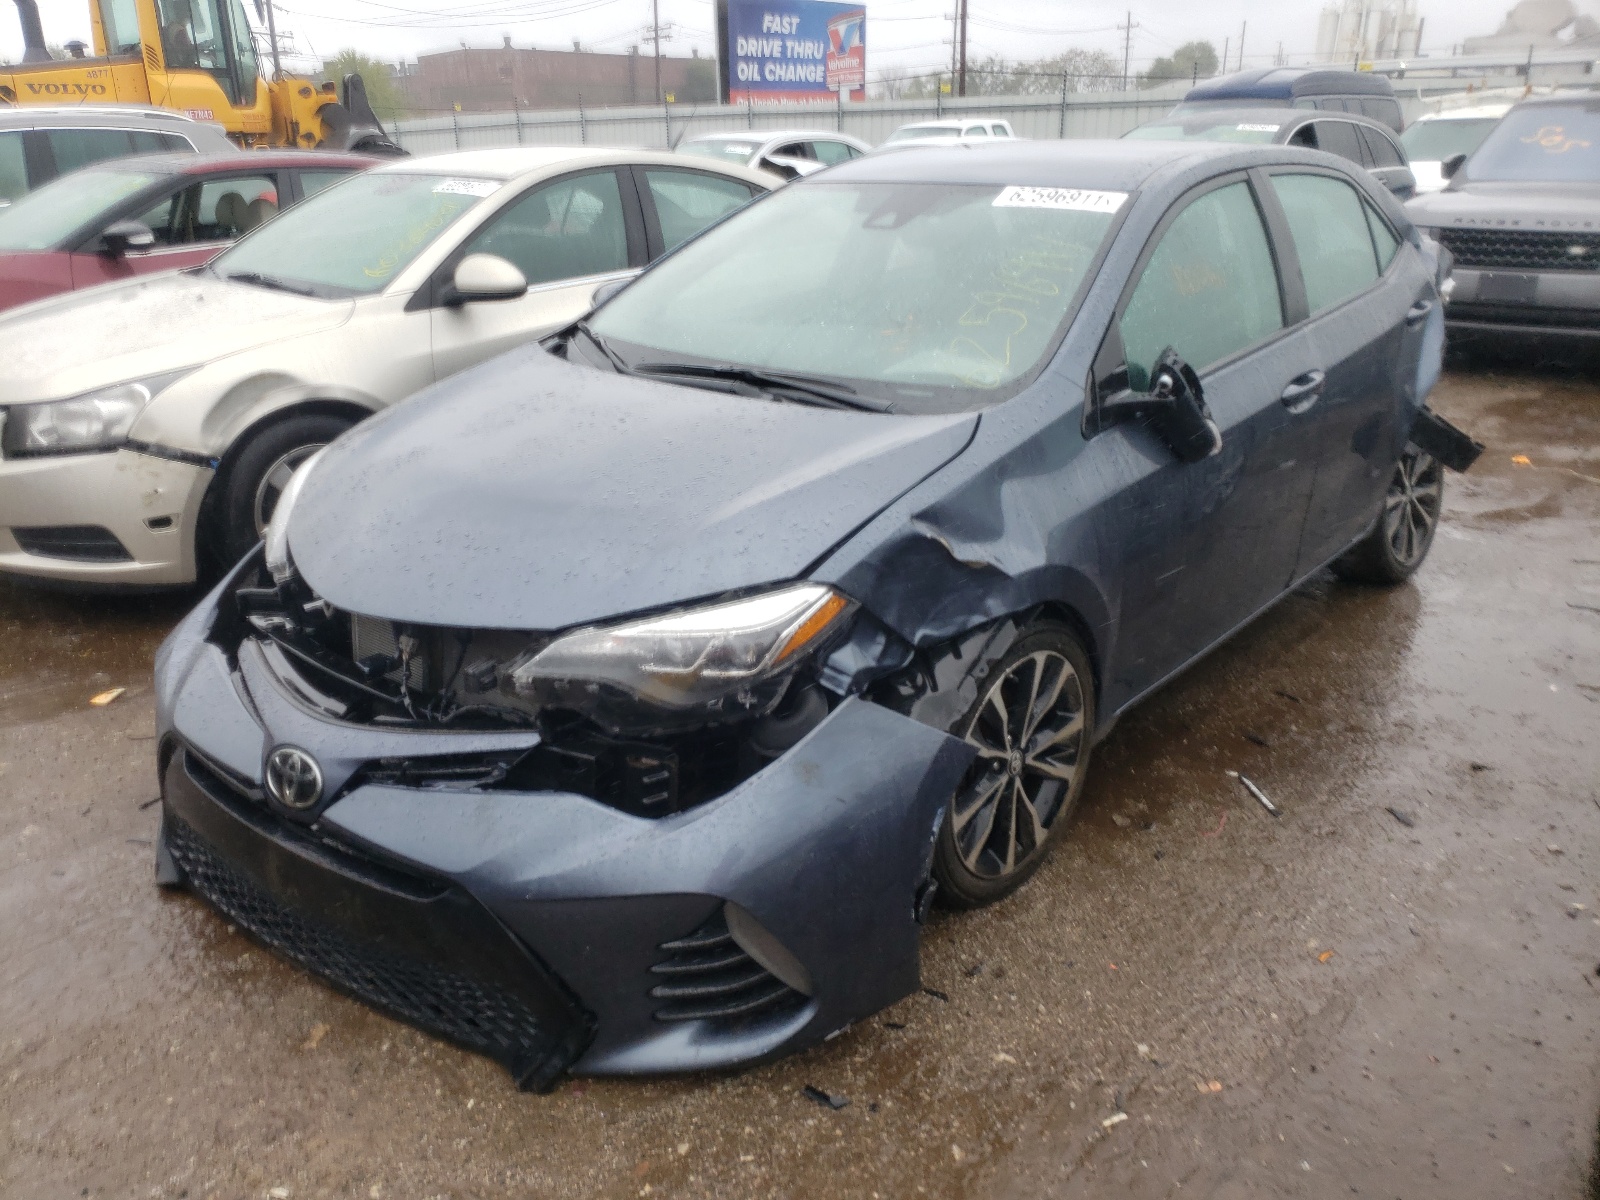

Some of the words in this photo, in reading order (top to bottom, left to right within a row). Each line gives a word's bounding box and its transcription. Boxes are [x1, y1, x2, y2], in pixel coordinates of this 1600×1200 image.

[762, 11, 801, 35] FAST
[737, 35, 783, 58] DRIVE
[785, 38, 825, 60] THRU
[828, 56, 860, 71] Valvoline
[86, 69, 109, 79] 4877
[737, 60, 761, 82] OIL
[763, 61, 825, 83] CHANGE
[26, 83, 107, 95] VOLVO
[1536, 218, 1600, 228] ROVE
